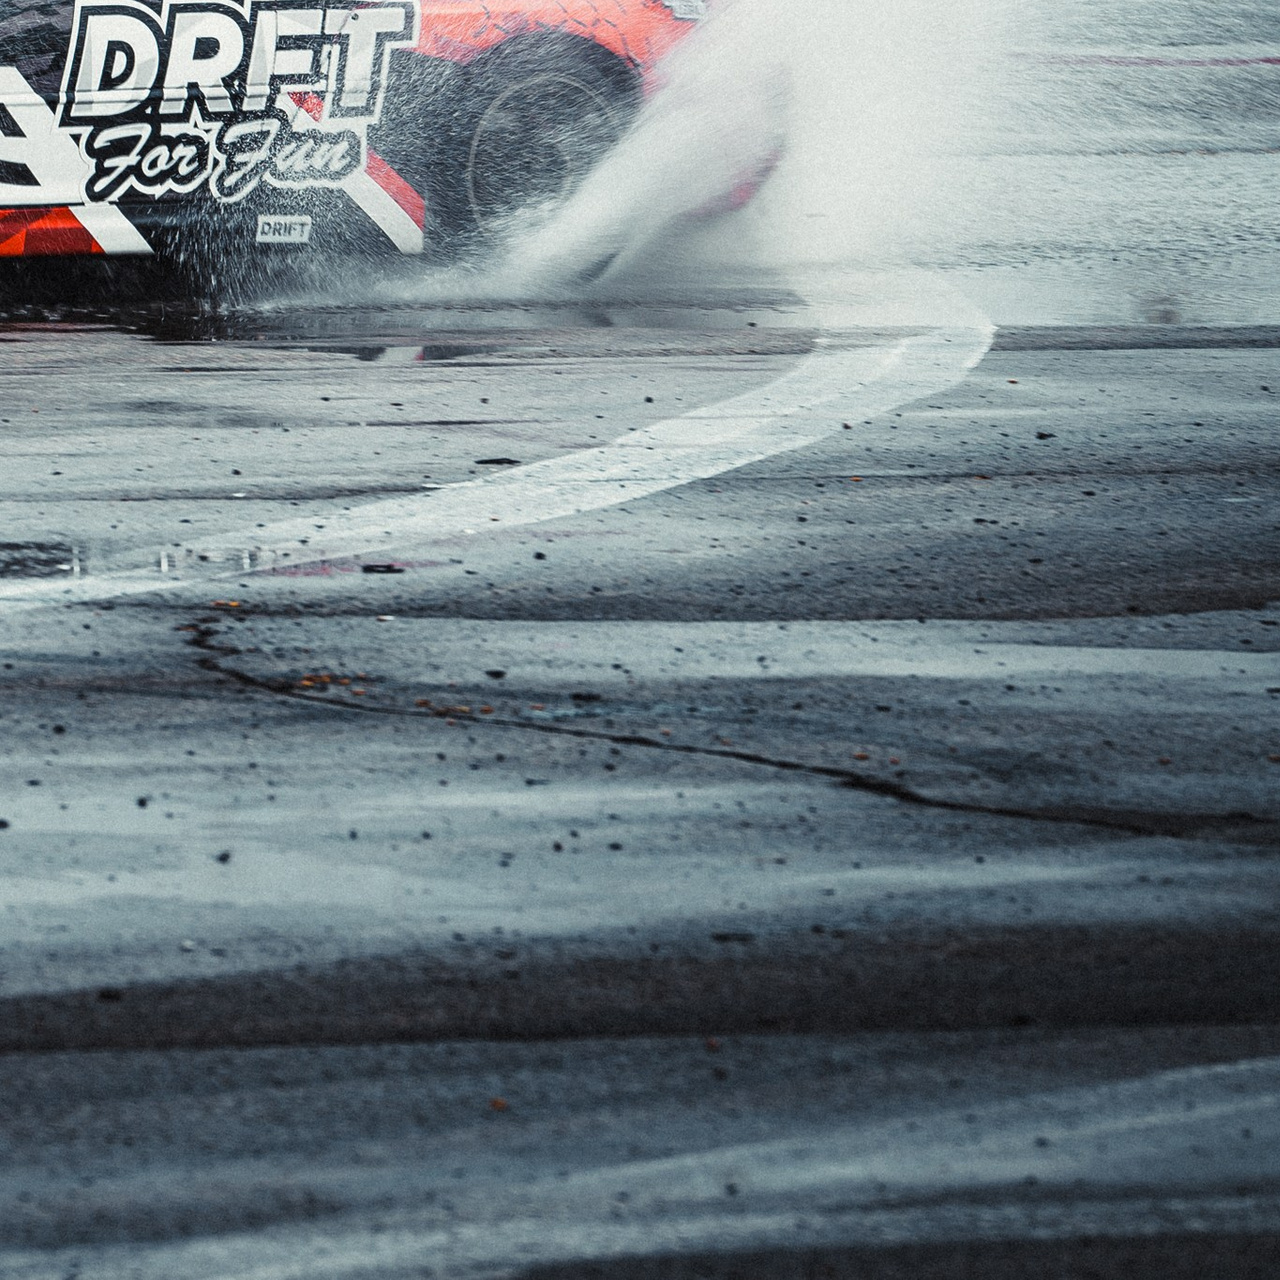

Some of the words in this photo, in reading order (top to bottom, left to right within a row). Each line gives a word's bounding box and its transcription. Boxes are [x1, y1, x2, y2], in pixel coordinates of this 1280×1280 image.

[93, 122, 200, 192] For
[220, 118, 351, 188] Fun
[261, 222, 310, 238] DRIFT
